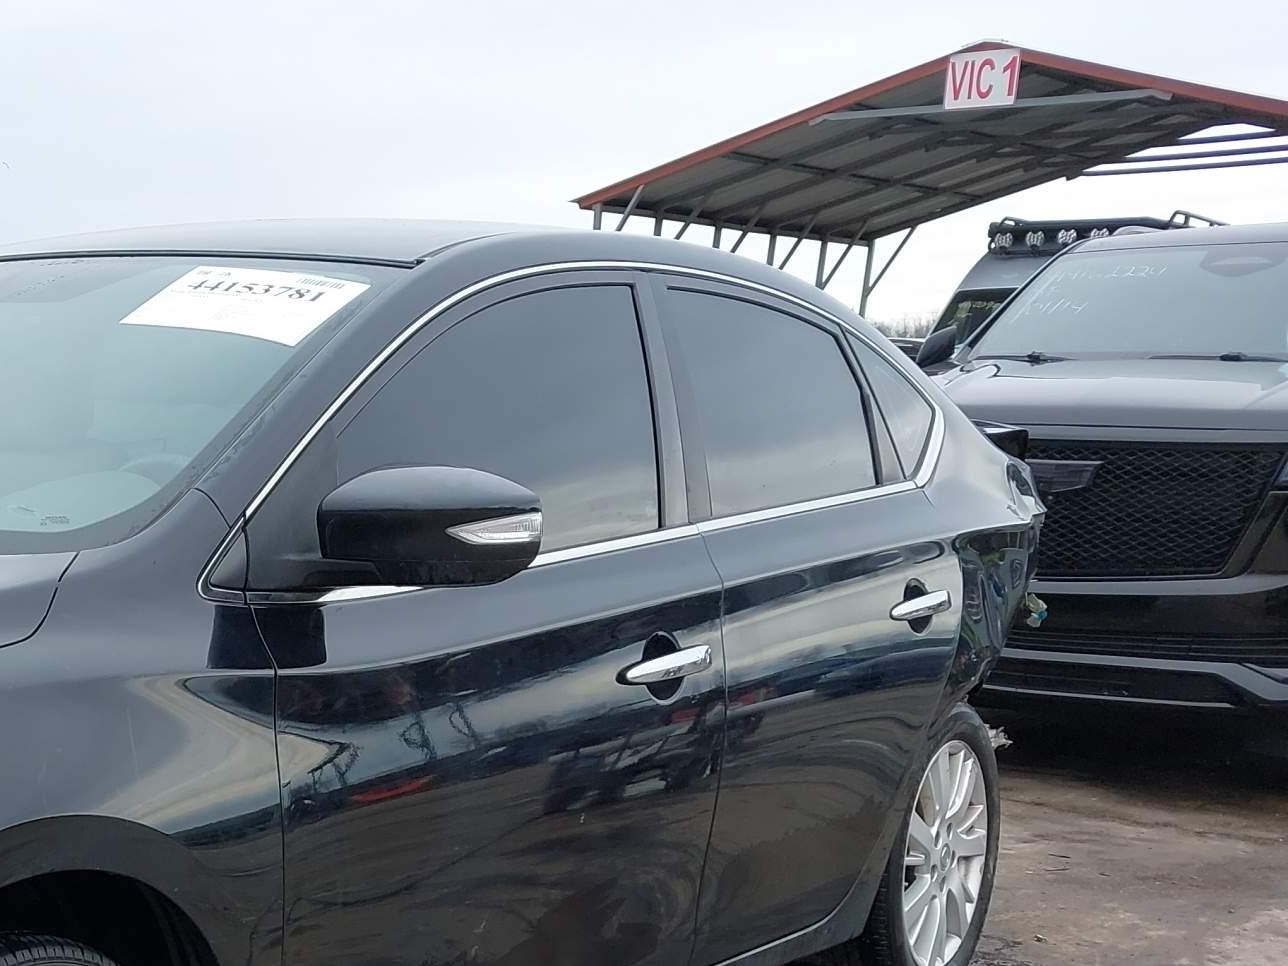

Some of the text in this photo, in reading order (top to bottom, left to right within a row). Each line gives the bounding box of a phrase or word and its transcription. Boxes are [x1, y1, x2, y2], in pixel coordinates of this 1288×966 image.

[951, 55, 1019, 101] VIC 1
[186, 278, 327, 302] 44153781
